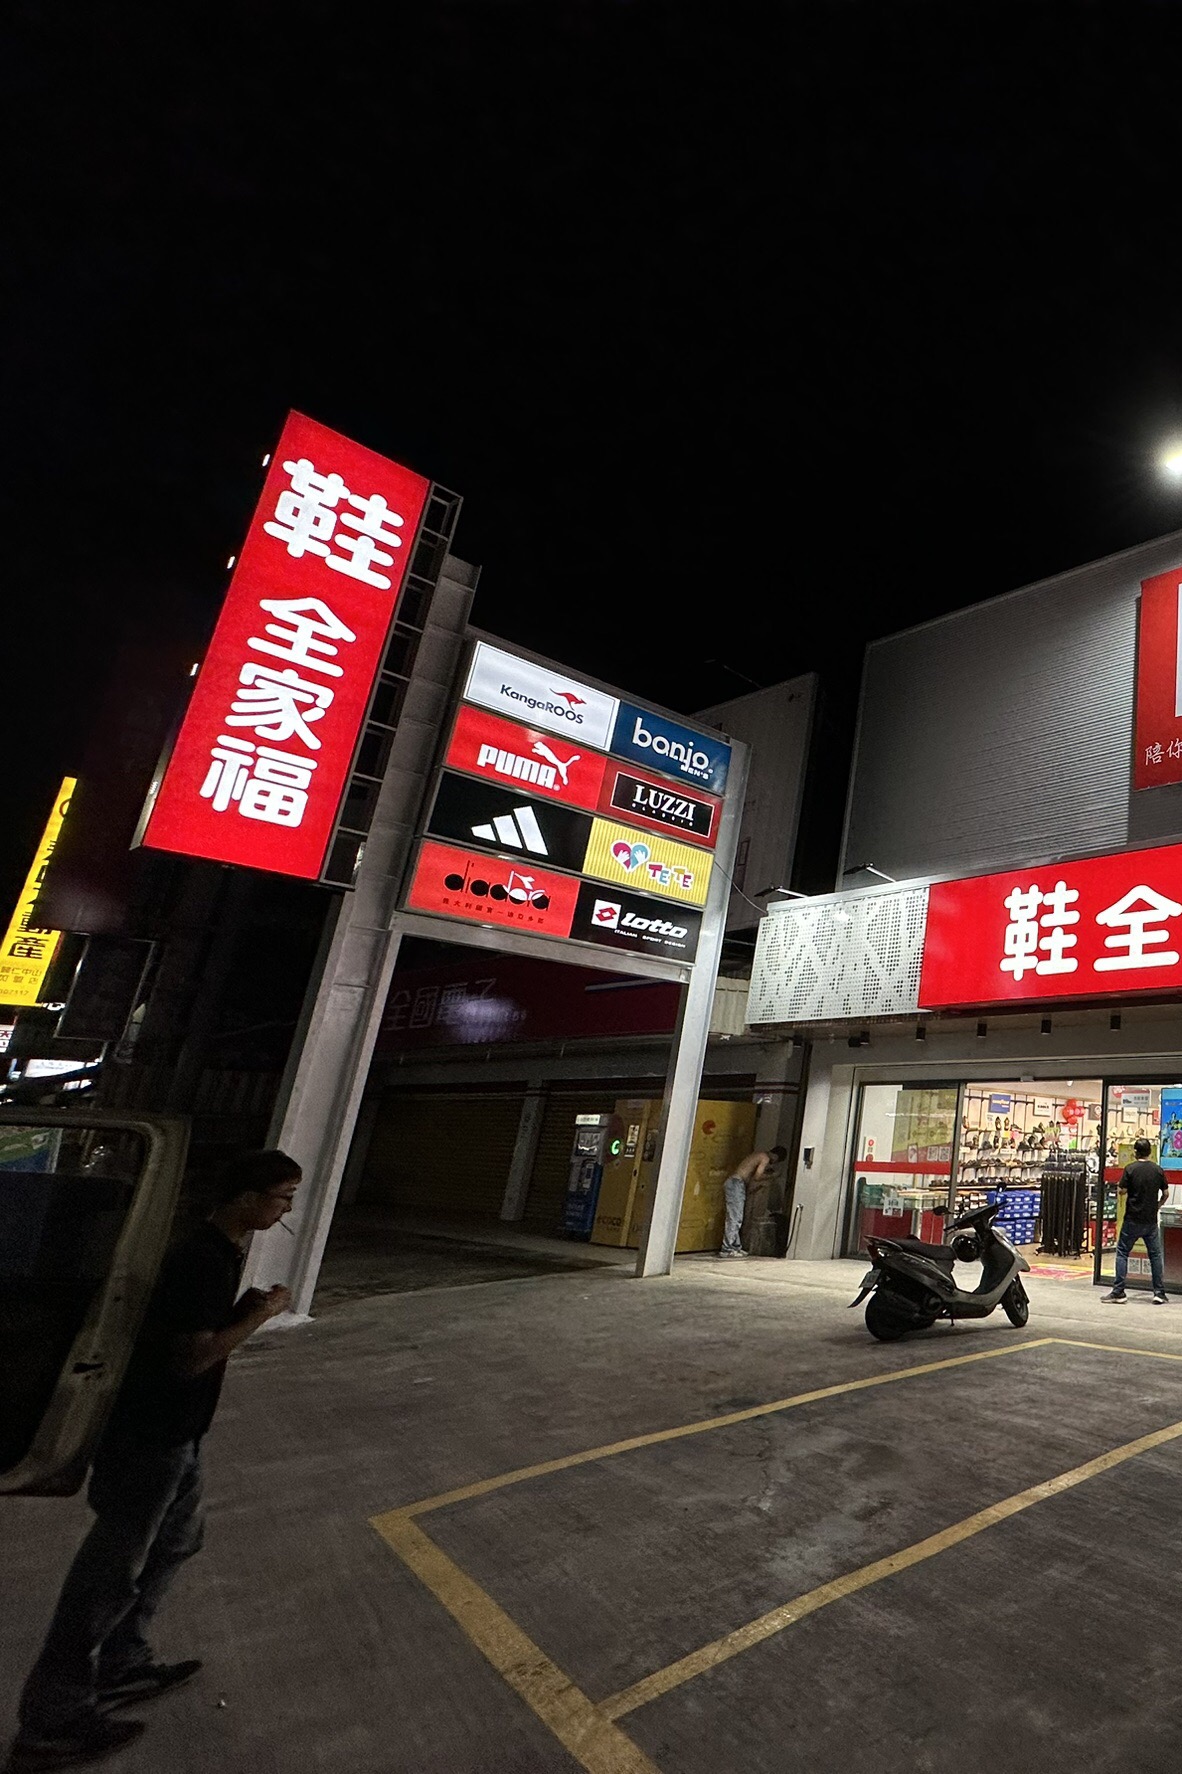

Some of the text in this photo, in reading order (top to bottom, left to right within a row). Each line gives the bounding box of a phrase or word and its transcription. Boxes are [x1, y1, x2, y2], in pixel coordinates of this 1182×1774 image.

[198, 458, 405, 829] 鞋全家福
[500, 684, 584, 725] KangaROOS
[476, 743, 557, 789] PUMA
[631, 717, 711, 770] banjo
[632, 784, 697, 821] LUZZI
[444, 859, 552, 911] diadora
